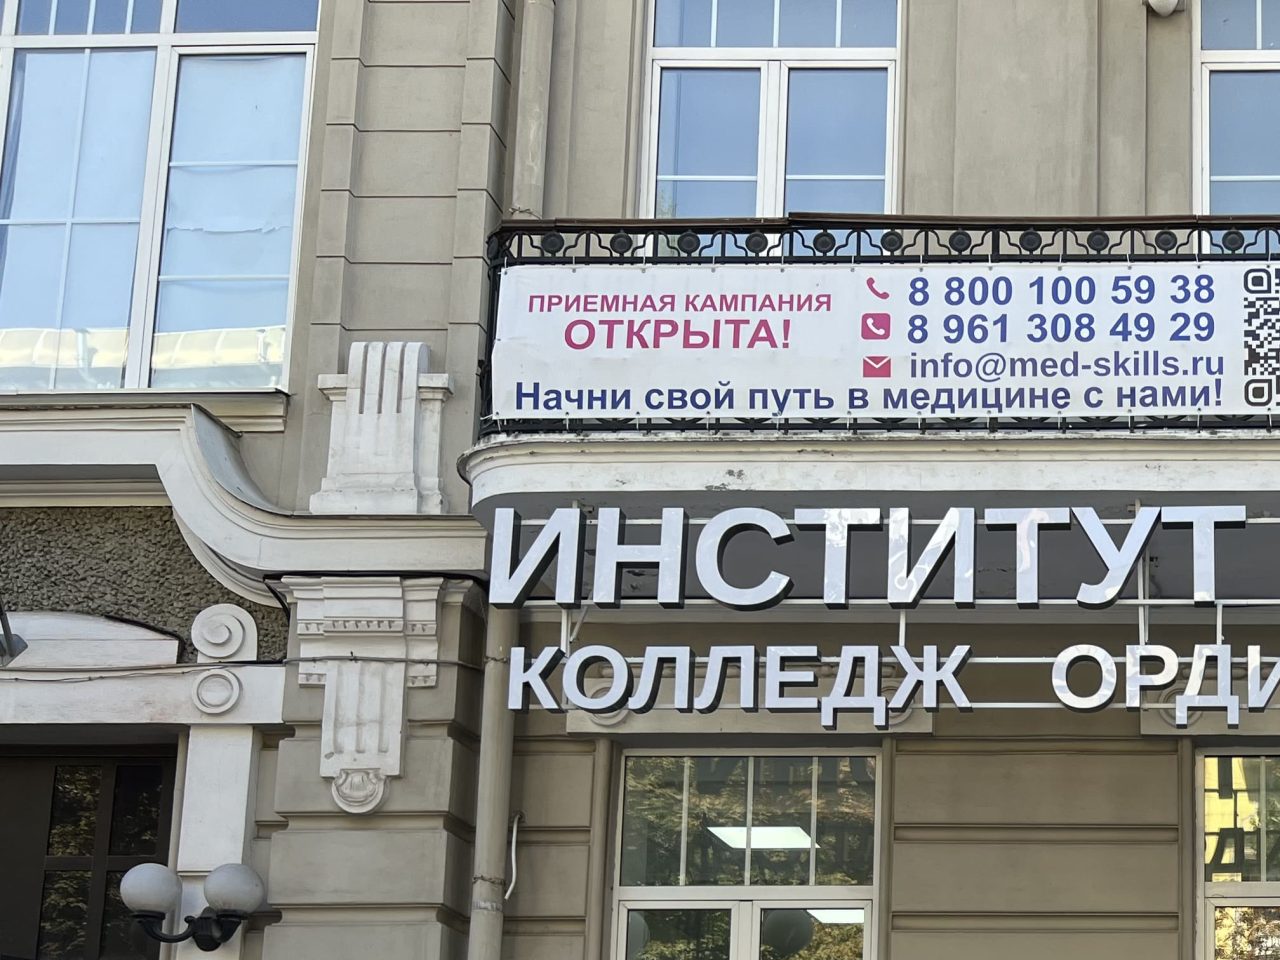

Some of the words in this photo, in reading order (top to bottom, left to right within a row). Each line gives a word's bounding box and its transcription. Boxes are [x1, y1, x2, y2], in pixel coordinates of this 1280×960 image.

[528, 294, 676, 312] ПРИЕМНАЯ
[684, 293, 832, 312] КАМПАНИЯ
[908, 277, 930, 306] 8
[944, 276, 1013, 304] 800
[1028, 276, 1096, 305] 100
[1110, 275, 1156, 304] 59
[1169, 274, 1215, 303] 38
[564, 319, 791, 350] ОТКРЫТА!
[907, 314, 929, 344] 8
[942, 313, 1008, 343] 961
[1026, 313, 1096, 343] 308
[1109, 312, 1155, 342] 49
[1169, 312, 1215, 341] 29
[909, 350, 1225, 382] info@med-skills.ru
[515, 382, 631, 411] Начни
[645, 380, 735, 409] свой
[749, 388, 835, 416] путь
[850, 388, 869, 409] в
[883, 385, 1071, 414] медицине
[1083, 386, 1104, 408] с
[1116, 379, 1223, 408] нами!
[488, 503, 1247, 609] ИНСТИТУТ
[508, 644, 973, 731] КОЛЛЕДЖ
